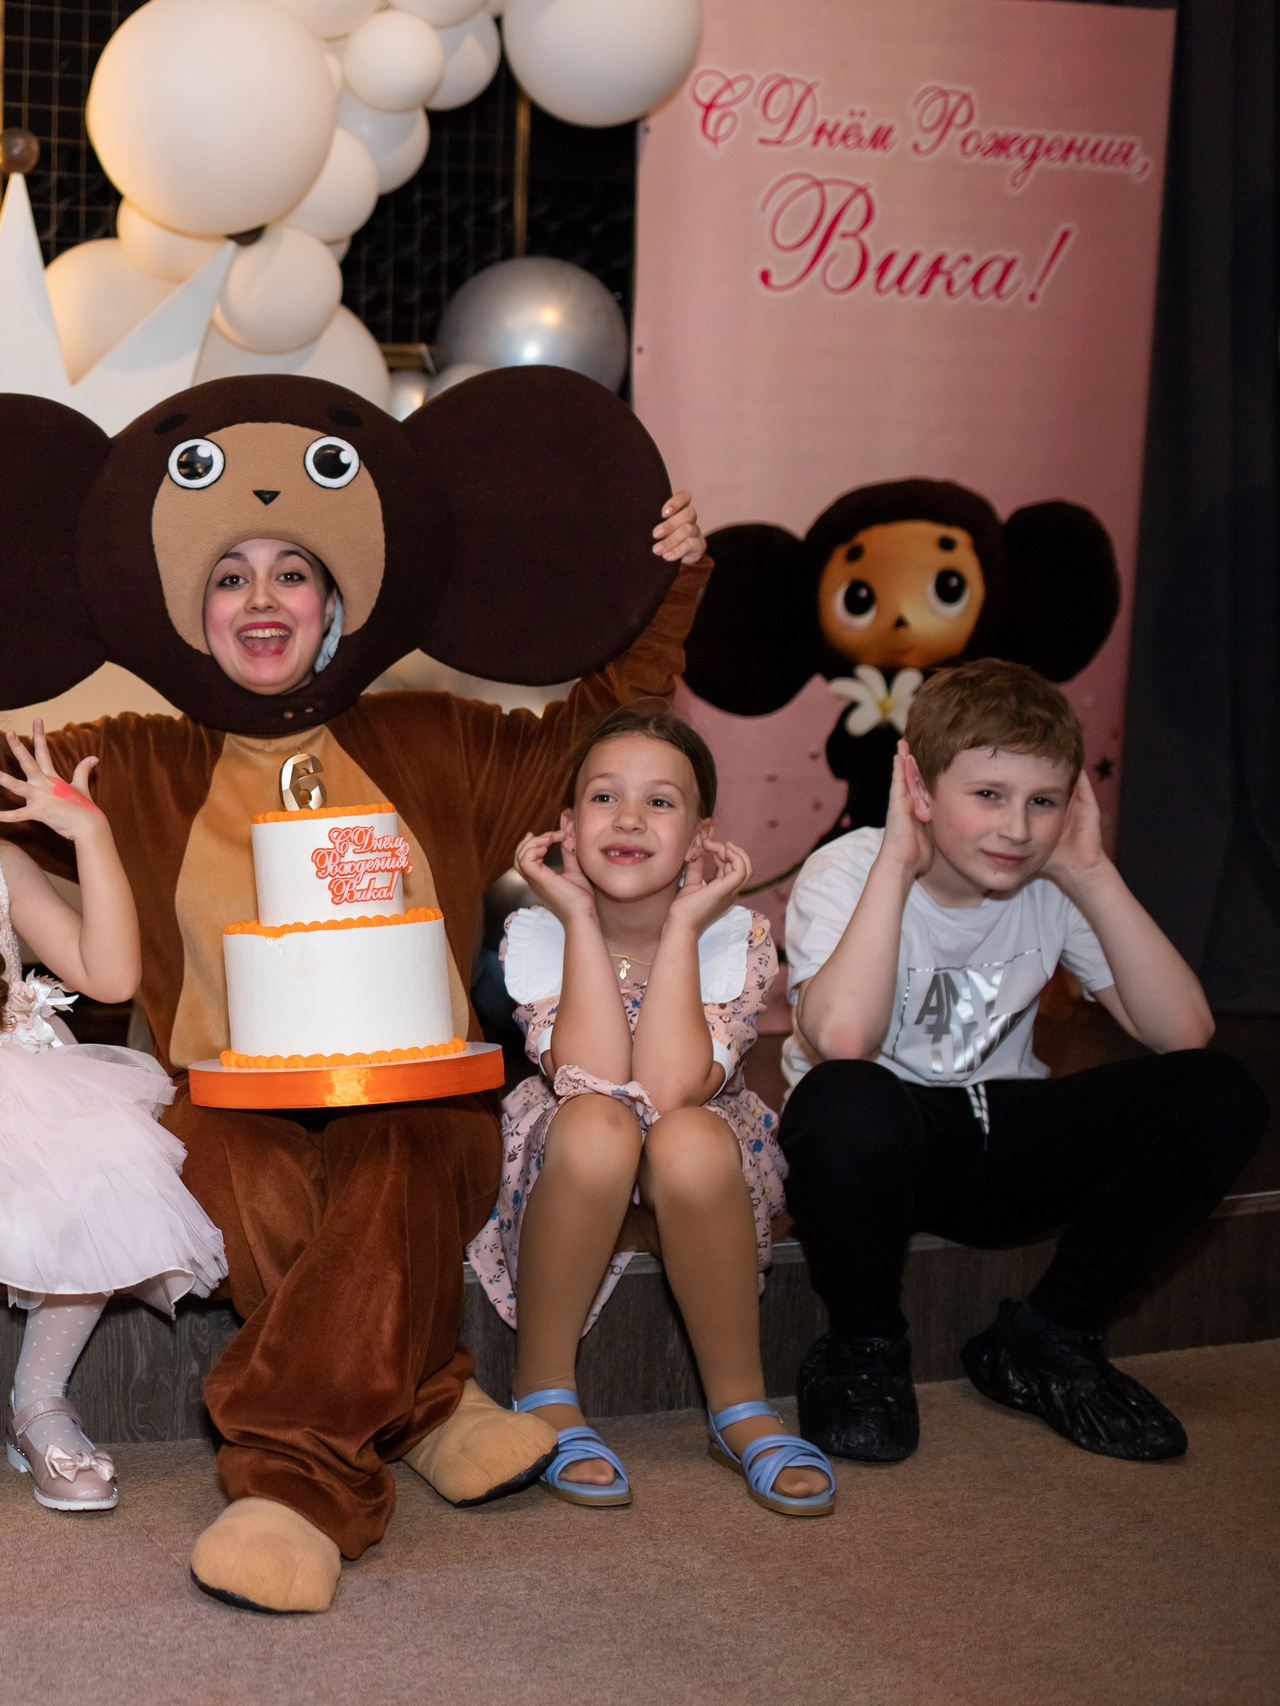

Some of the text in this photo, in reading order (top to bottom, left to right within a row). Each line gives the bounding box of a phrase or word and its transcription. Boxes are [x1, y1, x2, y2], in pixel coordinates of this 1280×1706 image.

[691, 69, 1152, 188] С Днём Рождения,
[760, 172, 1072, 303] Вика!
